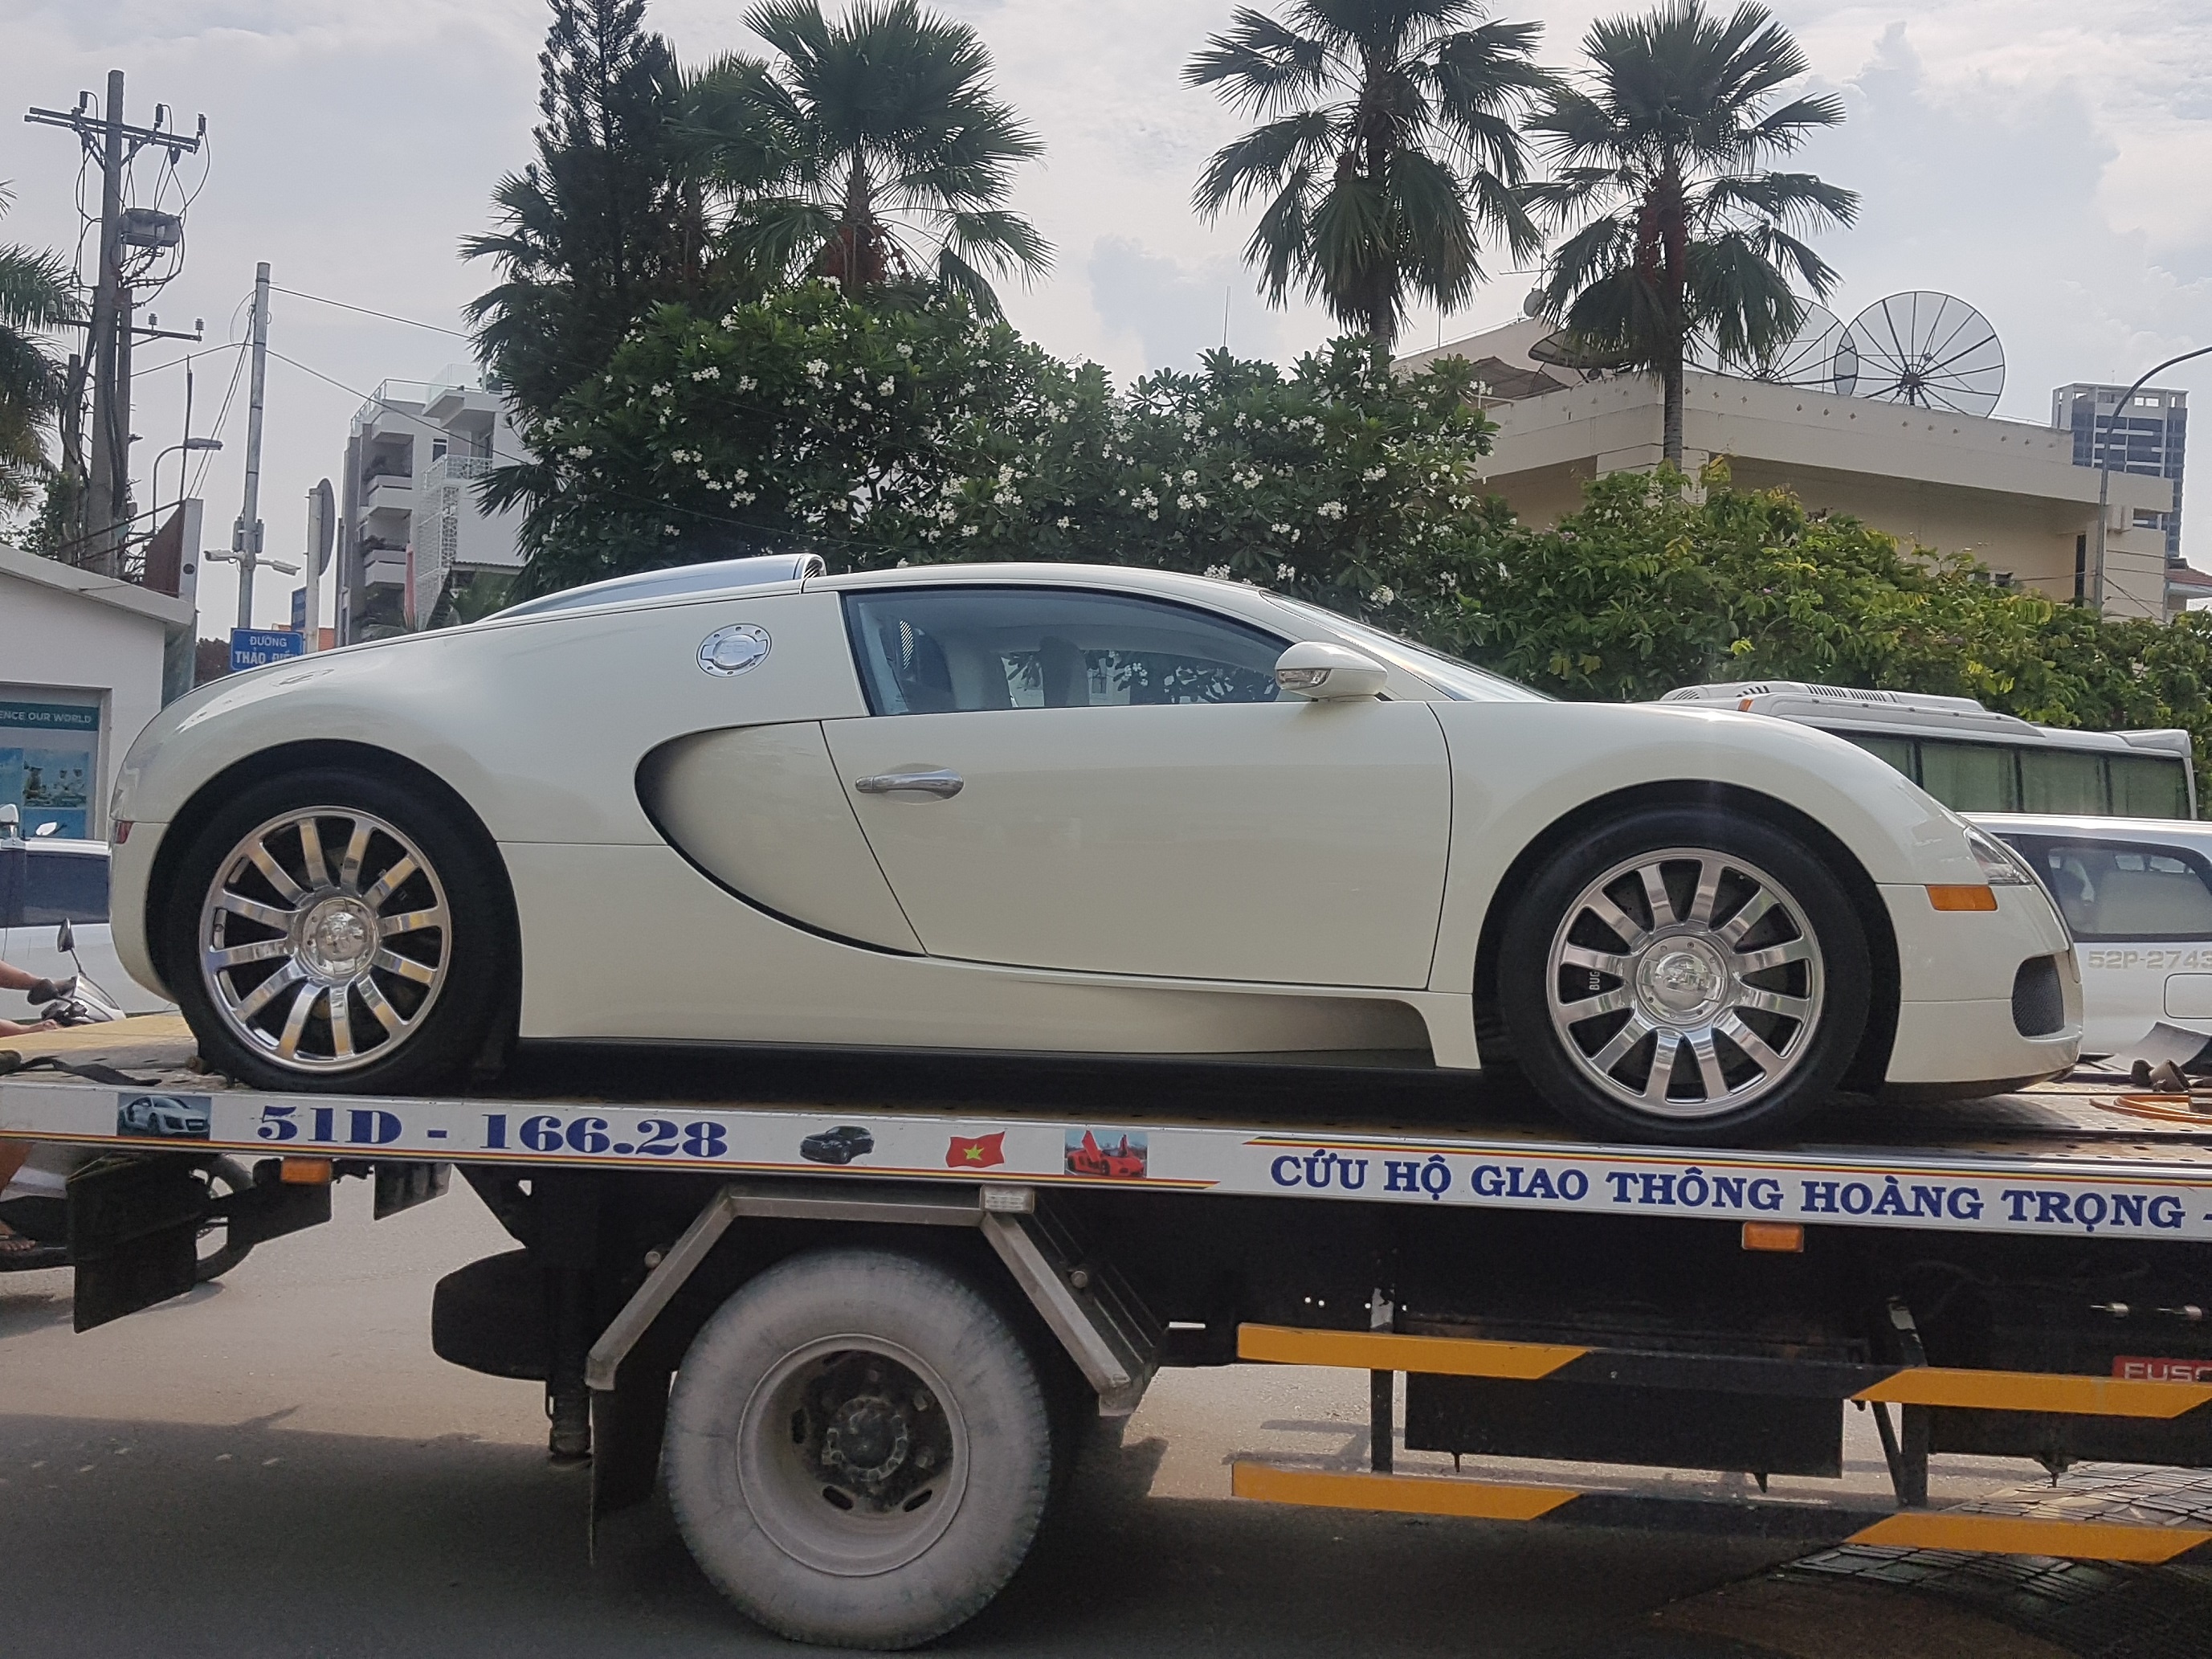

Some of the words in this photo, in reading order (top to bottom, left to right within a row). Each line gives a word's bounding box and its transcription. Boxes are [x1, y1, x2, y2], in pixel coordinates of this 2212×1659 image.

[249, 634, 288, 648] ĐƯỜNG
[235, 647, 267, 664] THẢO
[28, 712, 51, 721] OUR
[53, 713, 92, 724] WORLD
[257, 1105, 402, 1145] 51D
[480, 1114, 728, 1158] 166.28
[1270, 1149, 1369, 1191] CỨU
[1383, 1154, 1452, 1201] HỘ
[1471, 1165, 1590, 1201] GIAO
[1605, 1166, 1785, 1212] THÔNG
[1800, 1175, 1985, 1220] HOÀNG
[2000, 1188, 2186, 1233] TRỌNG
